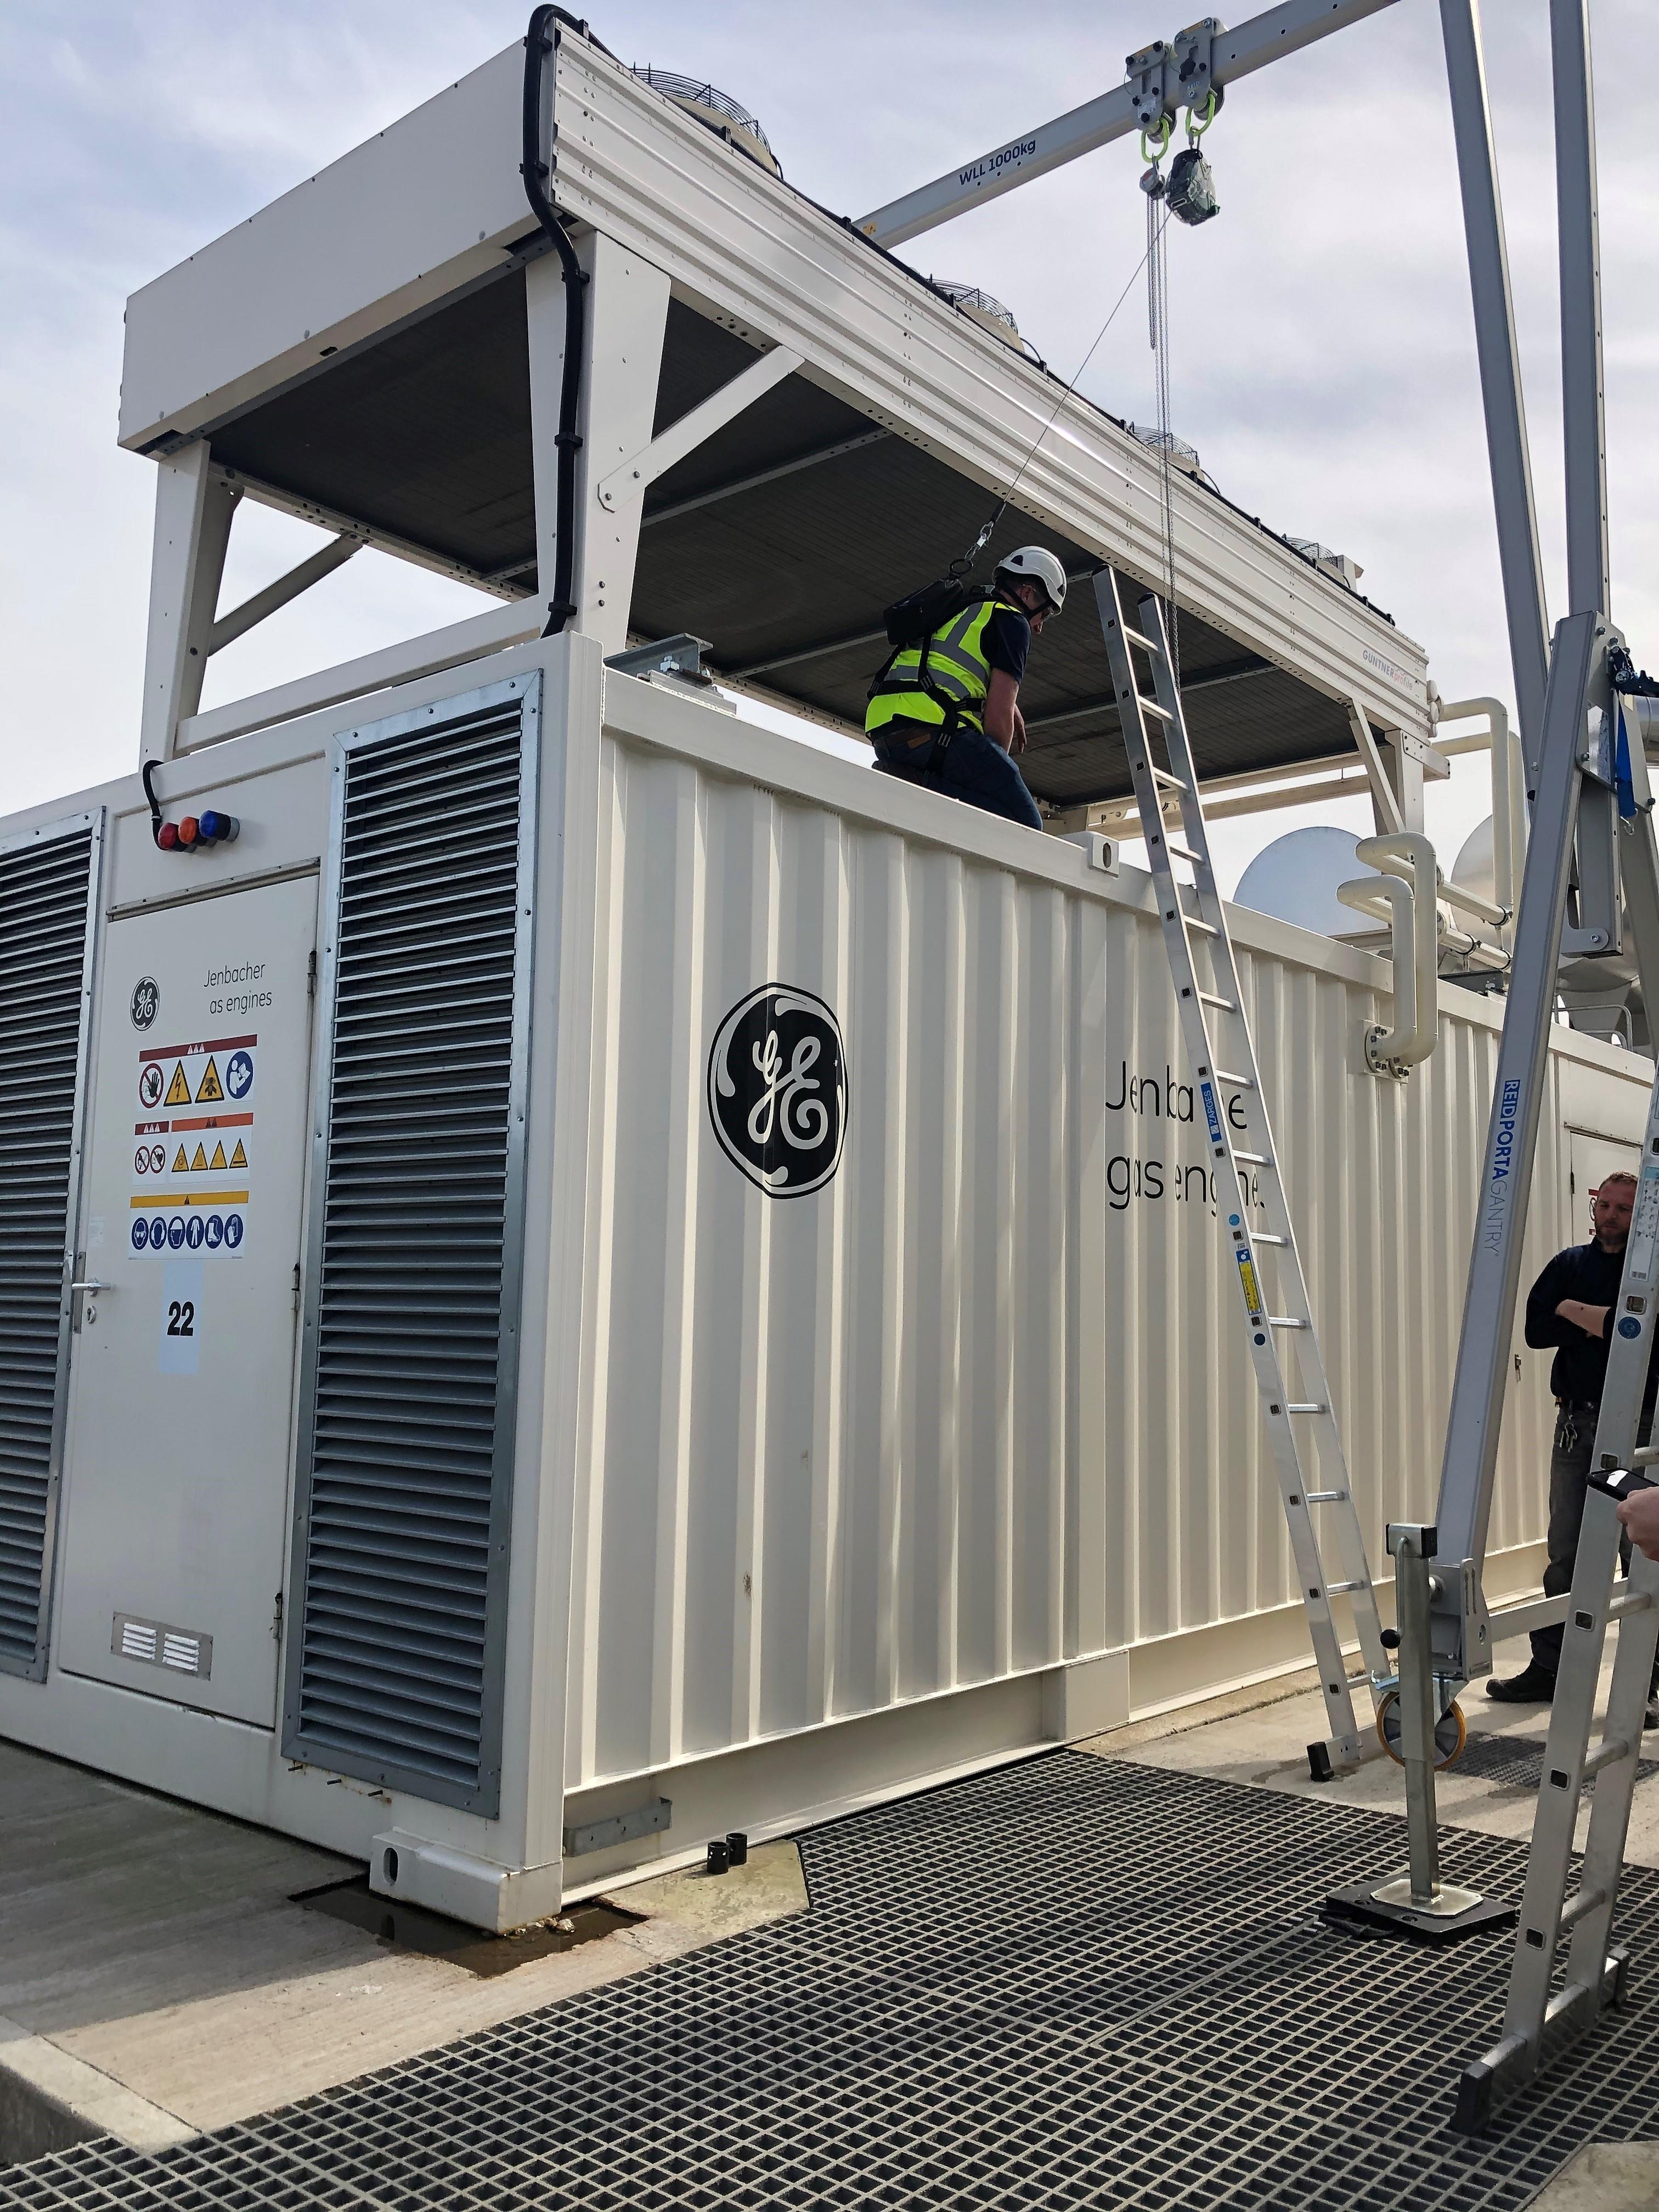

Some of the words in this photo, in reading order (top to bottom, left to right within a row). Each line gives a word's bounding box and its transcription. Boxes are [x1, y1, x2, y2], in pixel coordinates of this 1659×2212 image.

[959, 163, 986, 185] WLL
[989, 140, 1036, 172] 1000kg
[204, 961, 266, 988] Jenbacher
[210, 998, 223, 1014] as
[226, 990, 272, 1014] engines
[1105, 1060, 1248, 1130] Jenbae
[1204, 1090, 1217, 1125] ZARGES
[1107, 1156, 1164, 1210] gas
[1175, 1164, 1266, 1217] enne
[167, 1301, 194, 1336] 22
